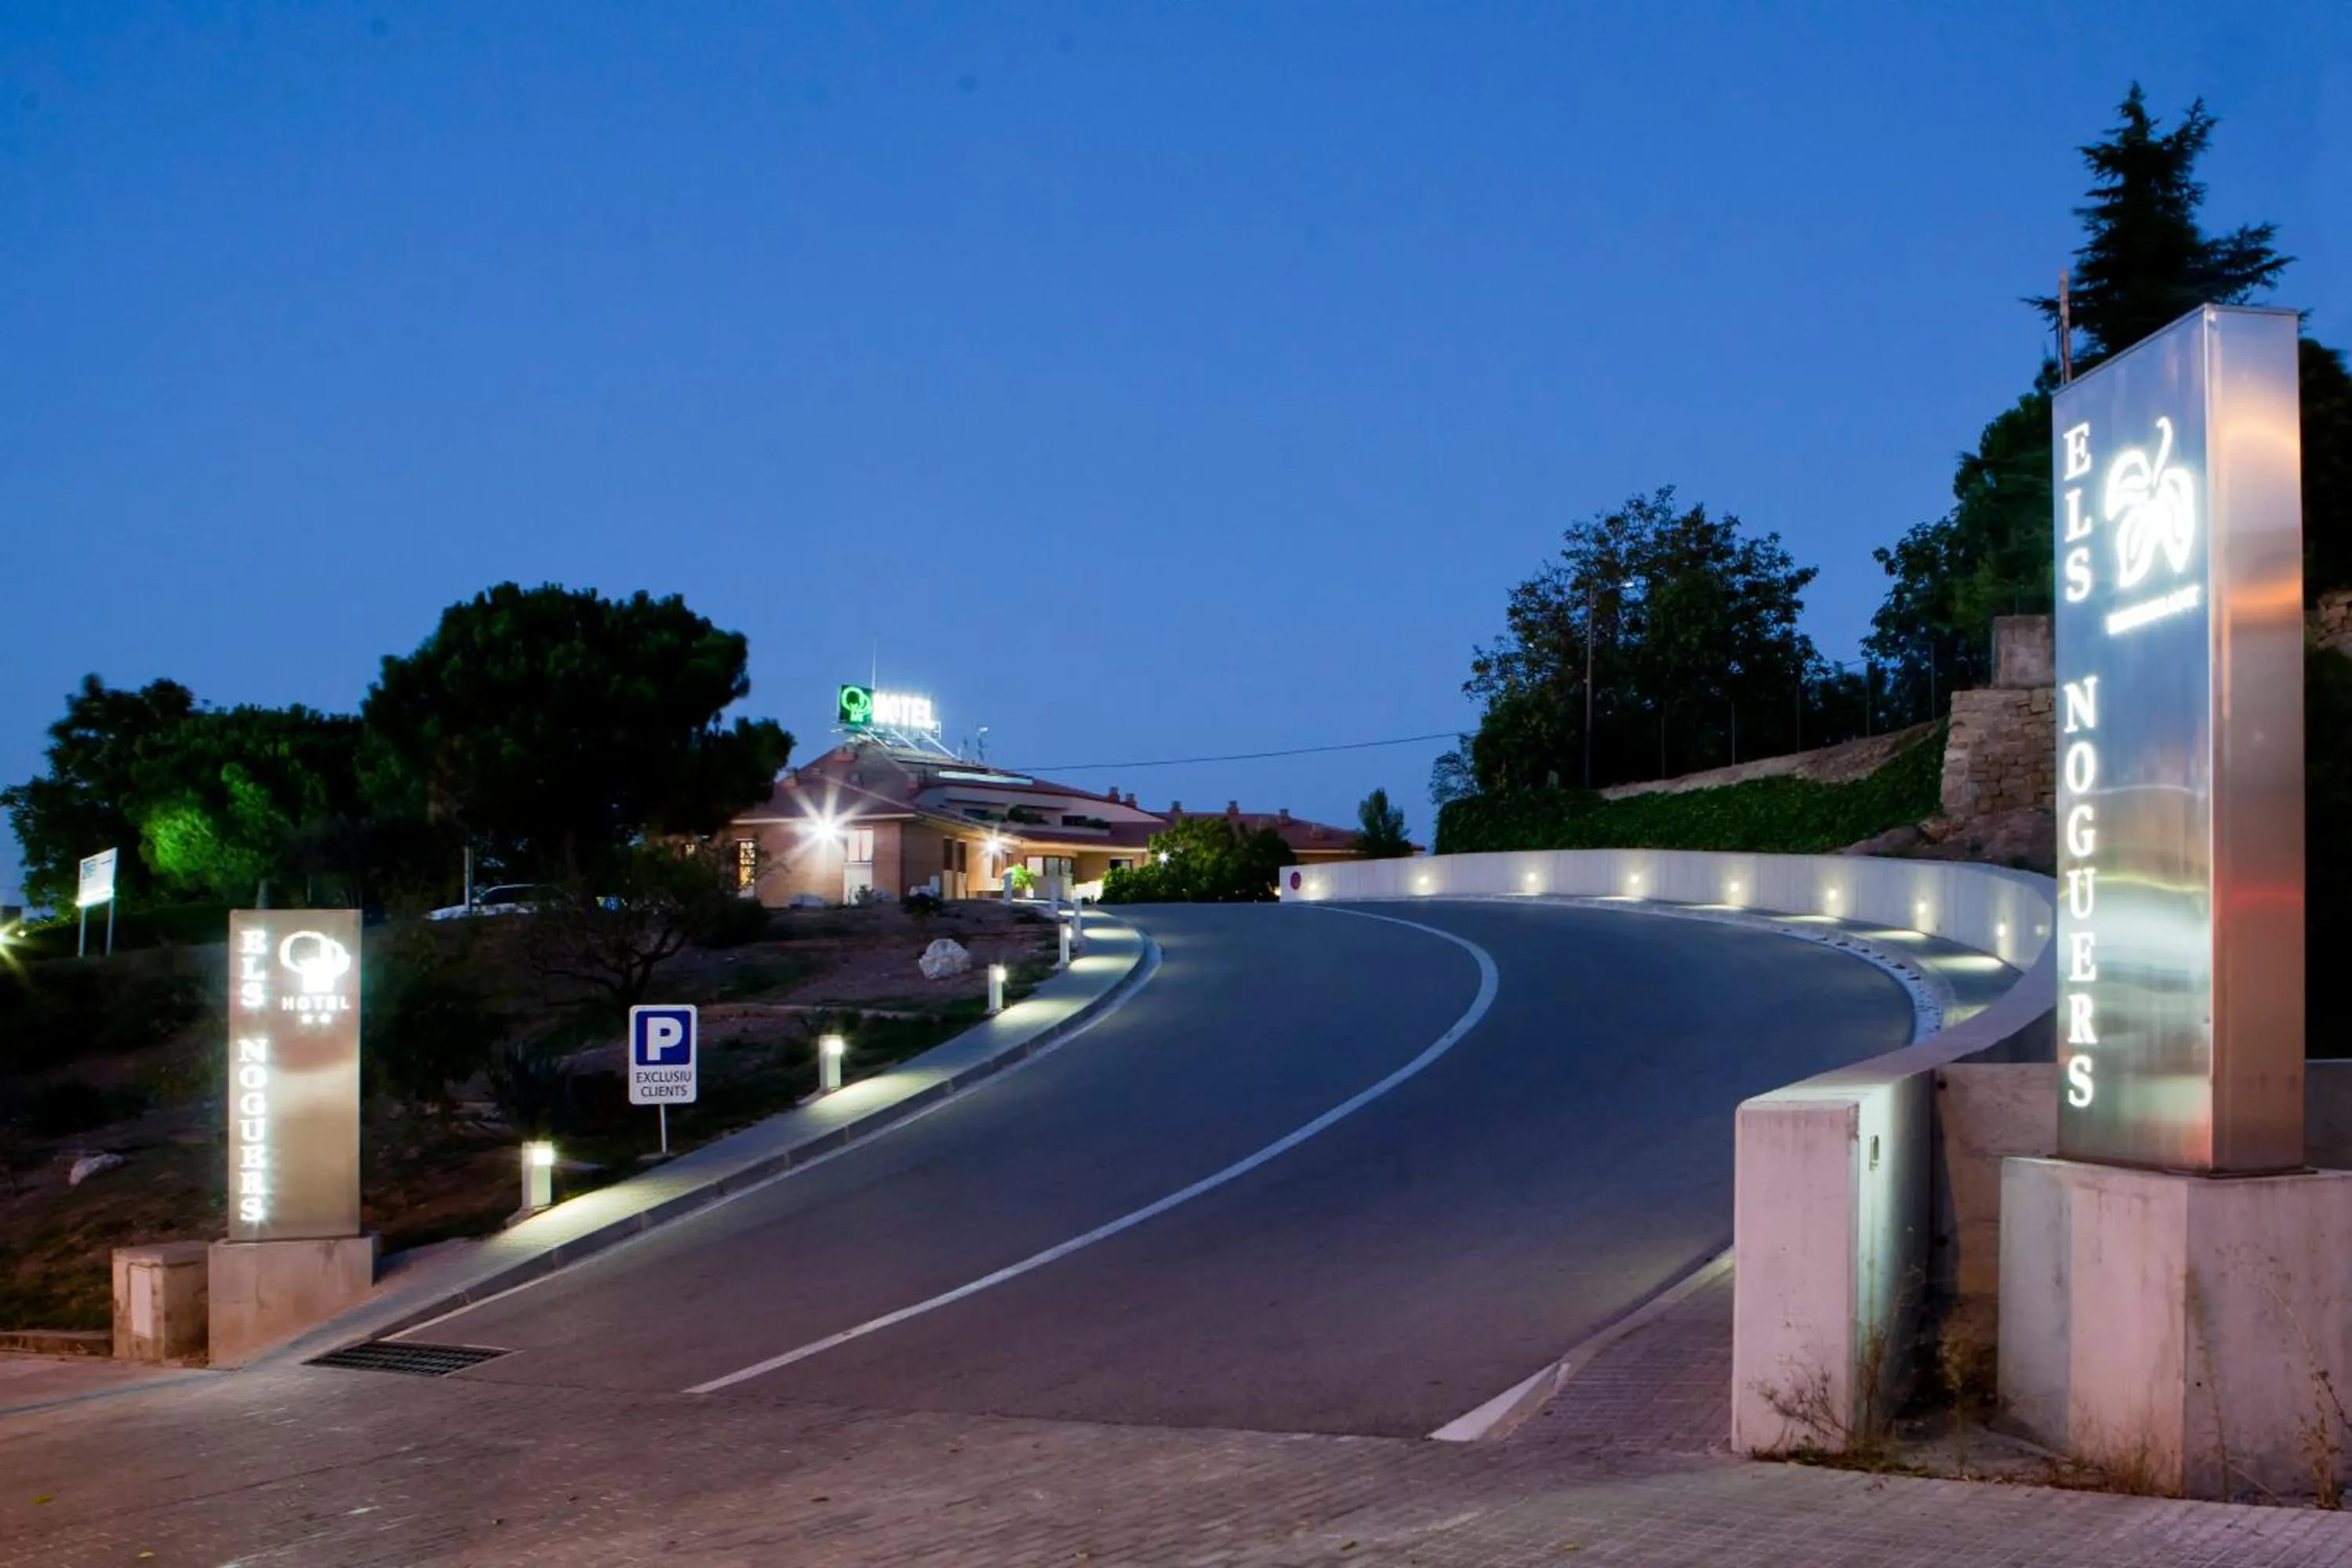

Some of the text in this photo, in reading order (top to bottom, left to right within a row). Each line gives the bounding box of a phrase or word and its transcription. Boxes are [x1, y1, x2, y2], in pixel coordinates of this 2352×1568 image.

[2063, 422, 2099, 1108] ELS NOGUERS
[281, 995, 351, 1011] HOTEL
[647, 1017, 683, 1061] P
[238, 929, 268, 1222] ELS NOGUERS
[636, 1070, 691, 1083] EXCLUSIU
[641, 1085, 688, 1098] CLIENTS
